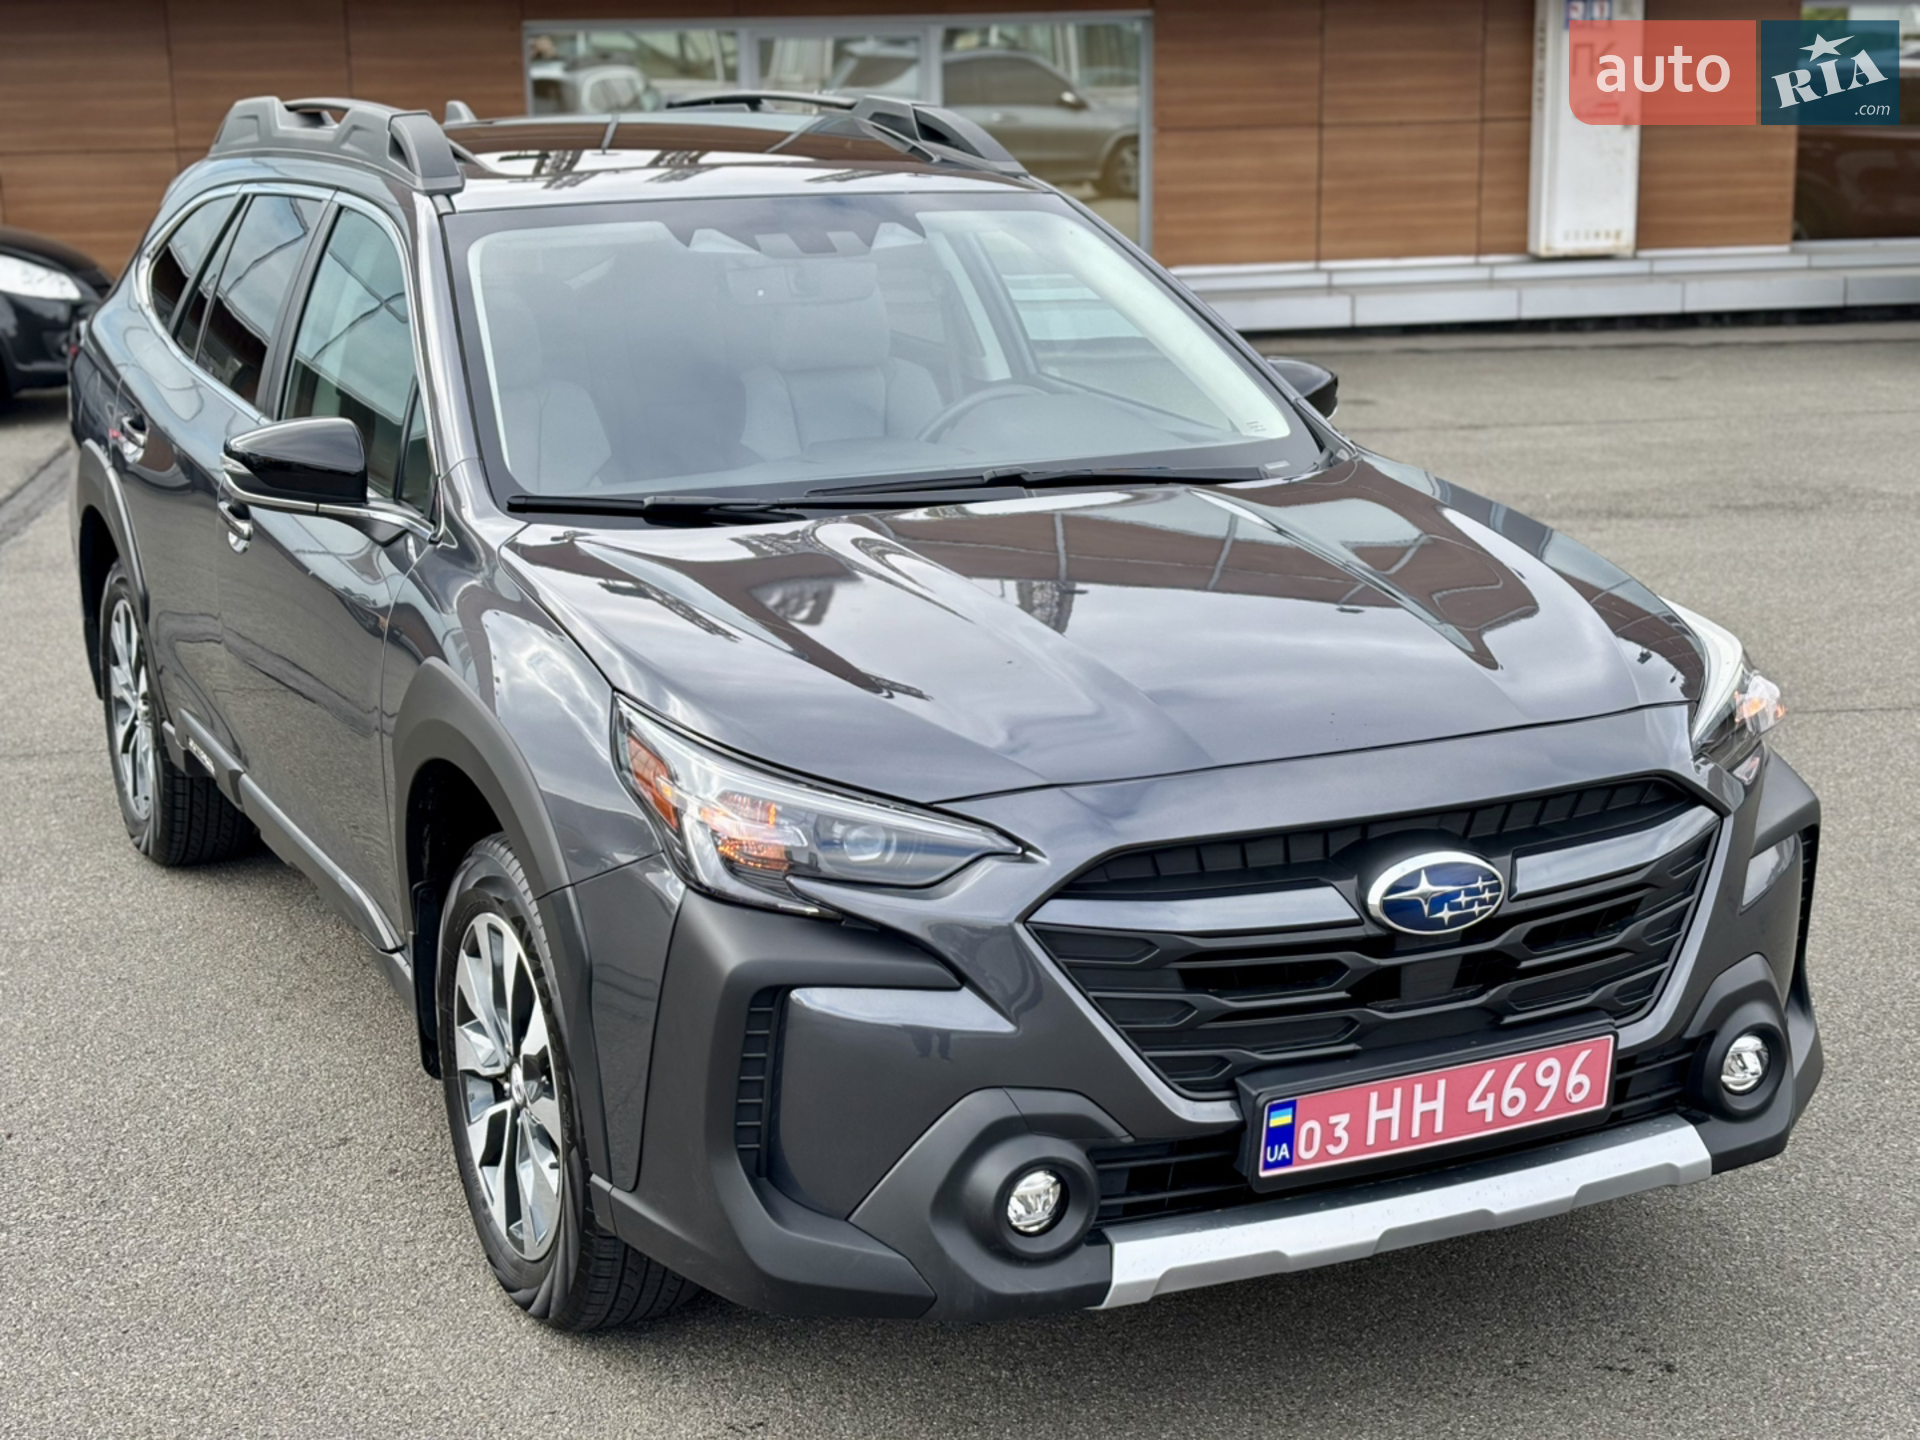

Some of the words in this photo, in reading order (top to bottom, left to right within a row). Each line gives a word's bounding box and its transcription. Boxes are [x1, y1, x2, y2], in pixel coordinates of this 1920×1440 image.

[1297, 1112, 1351, 1161] 03
[1366, 1078, 1447, 1146] HH
[1467, 1048, 1593, 1123] 4696
[1265, 1142, 1291, 1163] UA
